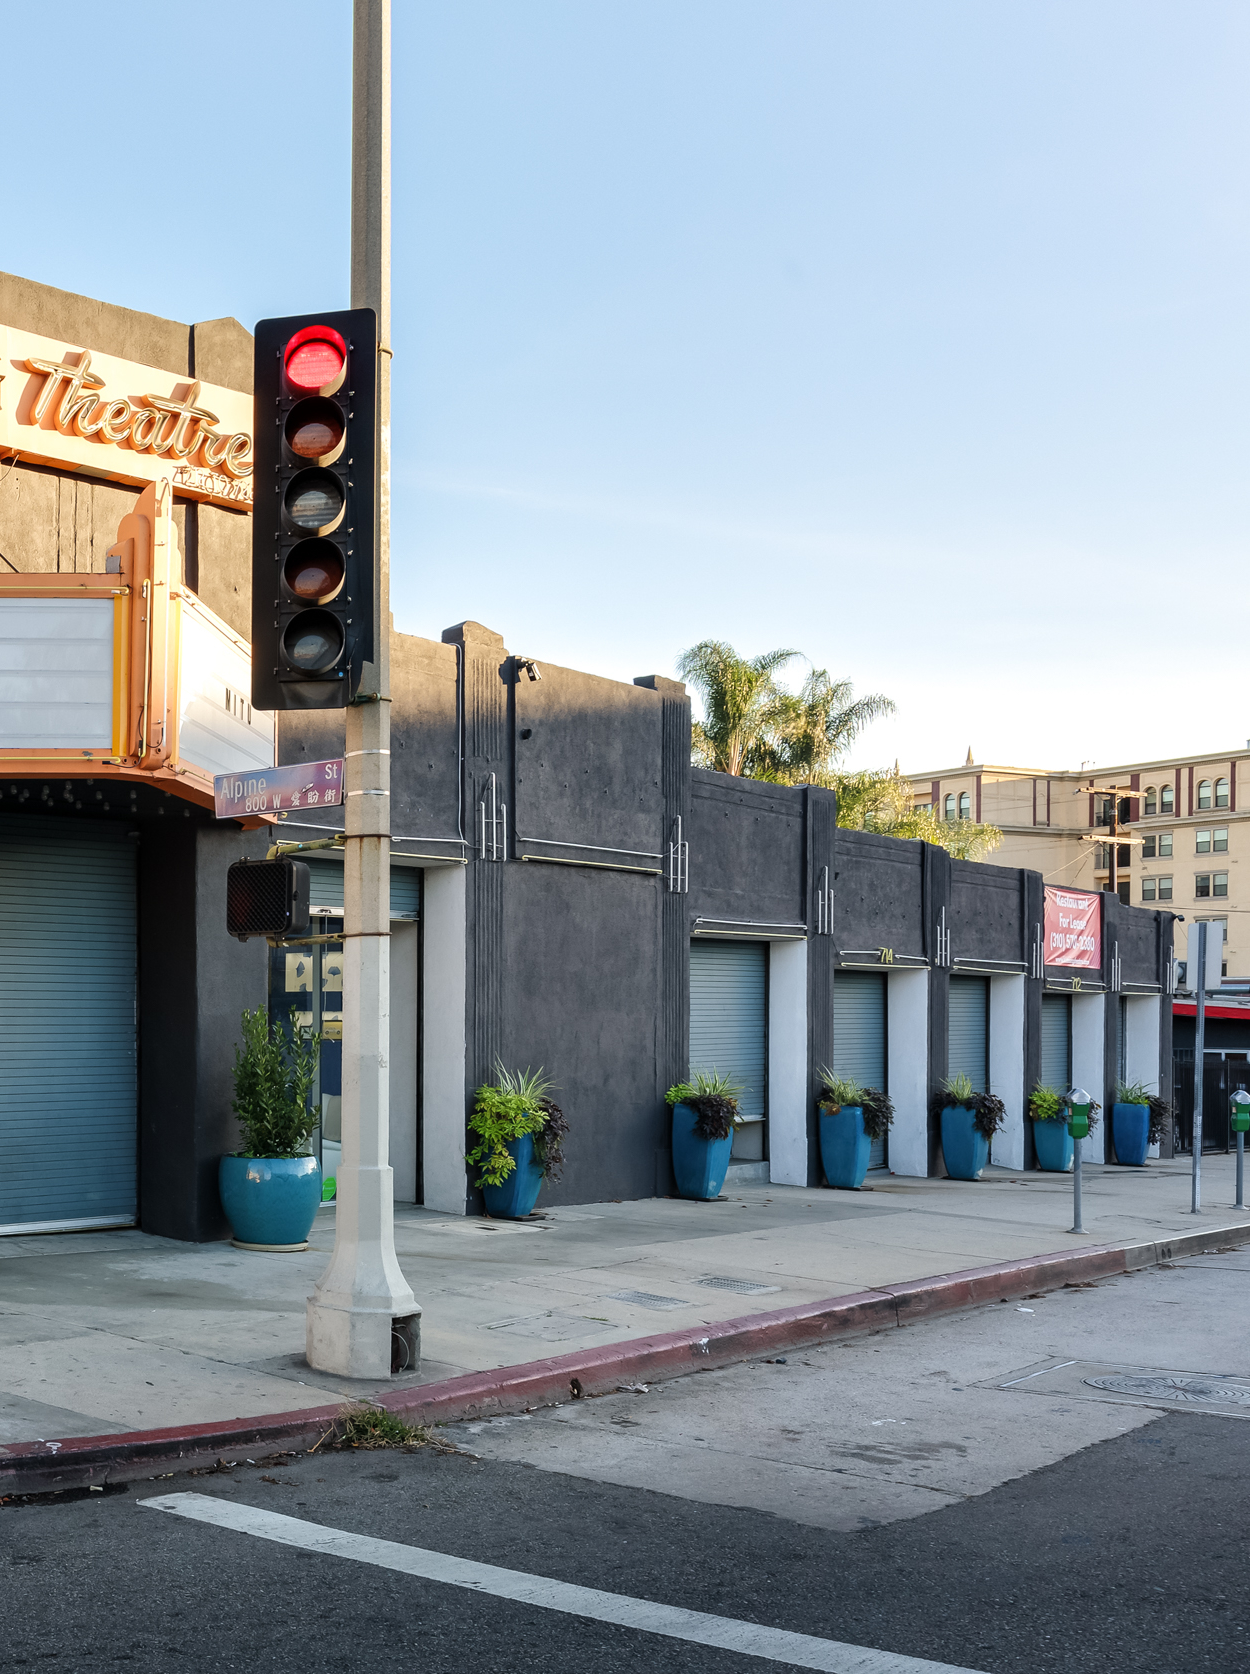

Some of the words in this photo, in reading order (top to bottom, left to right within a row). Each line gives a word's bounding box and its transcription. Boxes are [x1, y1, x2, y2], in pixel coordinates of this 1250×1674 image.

[24, 350, 253, 478] Theatre
[220, 777, 267, 803] Alpine
[324, 763, 338, 780] St
[245, 795, 267, 812] 800
[273, 794, 281, 809] W
[1059, 913, 1069, 928] For
[1070, 914, 1087, 930] Lease
[1050, 931, 1065, 951] (310)
